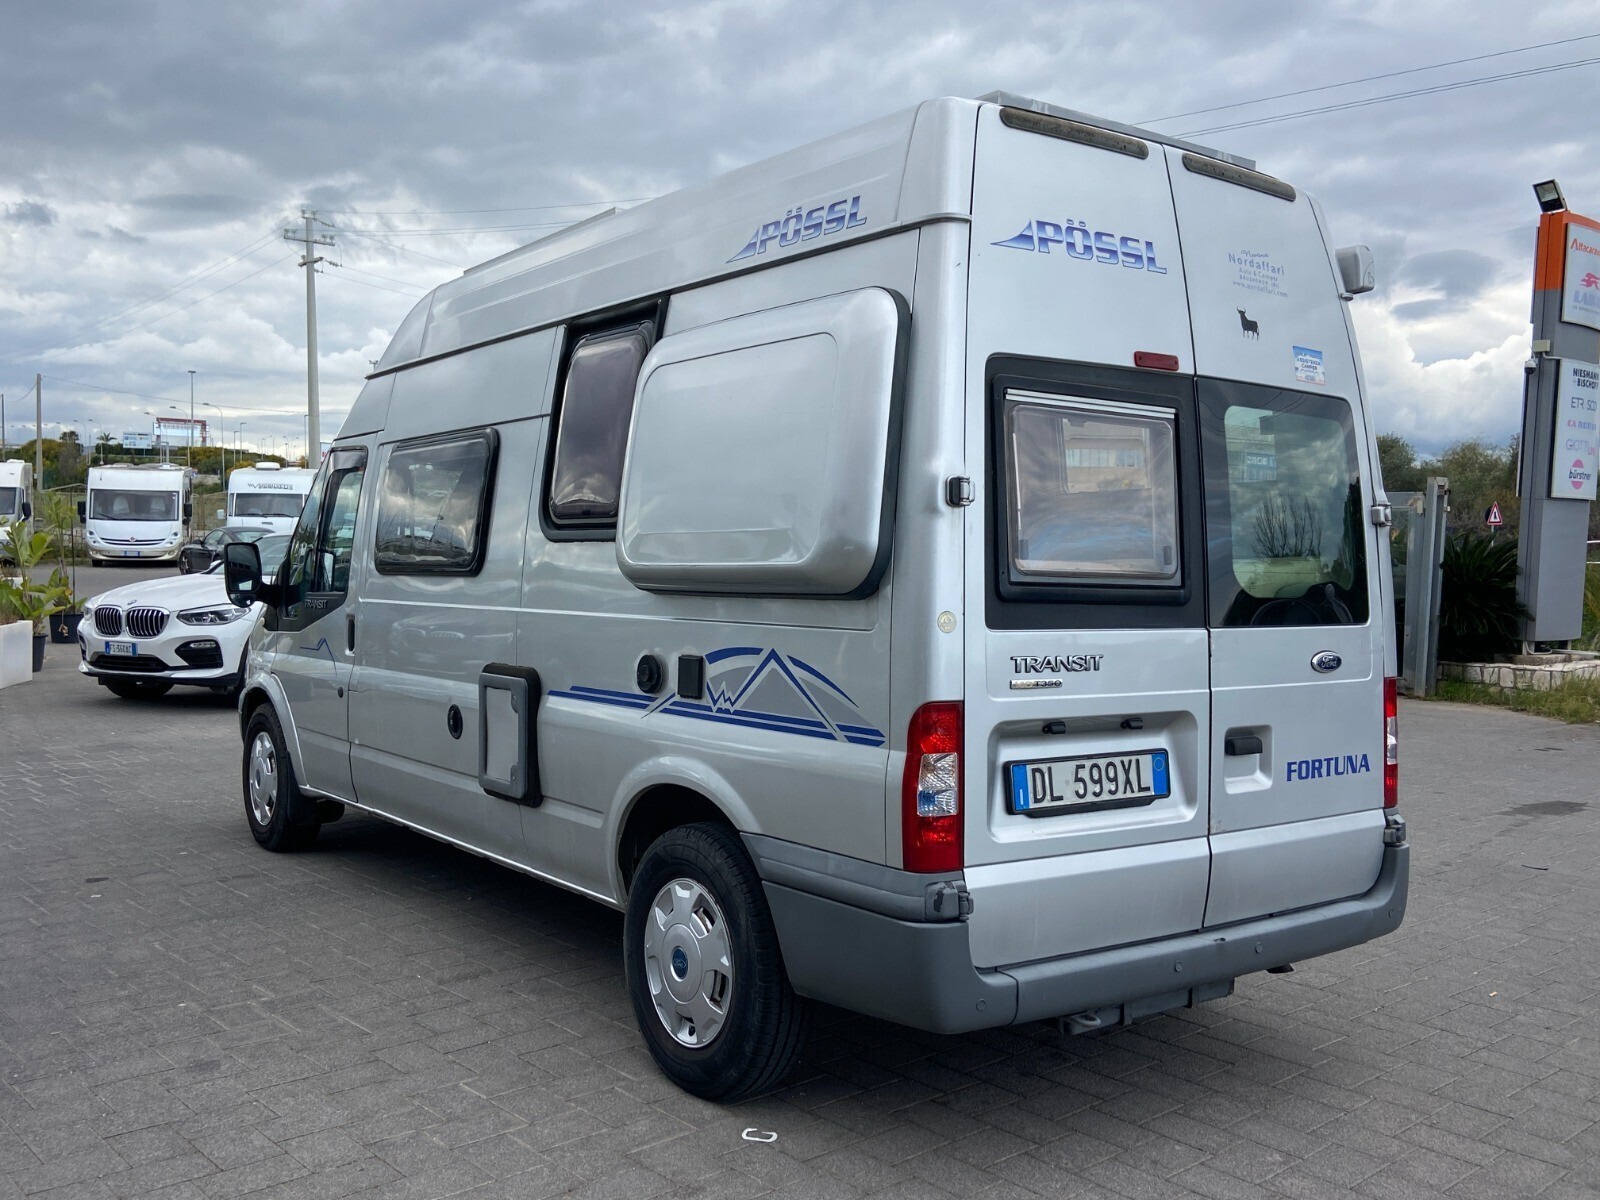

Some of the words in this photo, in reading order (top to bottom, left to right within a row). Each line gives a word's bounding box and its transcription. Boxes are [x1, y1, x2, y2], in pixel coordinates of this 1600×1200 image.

[757, 195, 868, 254] PÖSSL
[1036, 219, 1167, 274] PÖSSL
[1228, 252, 1285, 275] Nordaffari
[305, 599, 328, 610] TRANSIT
[1009, 653, 1104, 674] TRANSIT
[1319, 654, 1338, 669] Ford
[1031, 766, 1064, 804] DL
[1073, 757, 1151, 800] 599XL
[1286, 753, 1371, 782] FORTUNA
